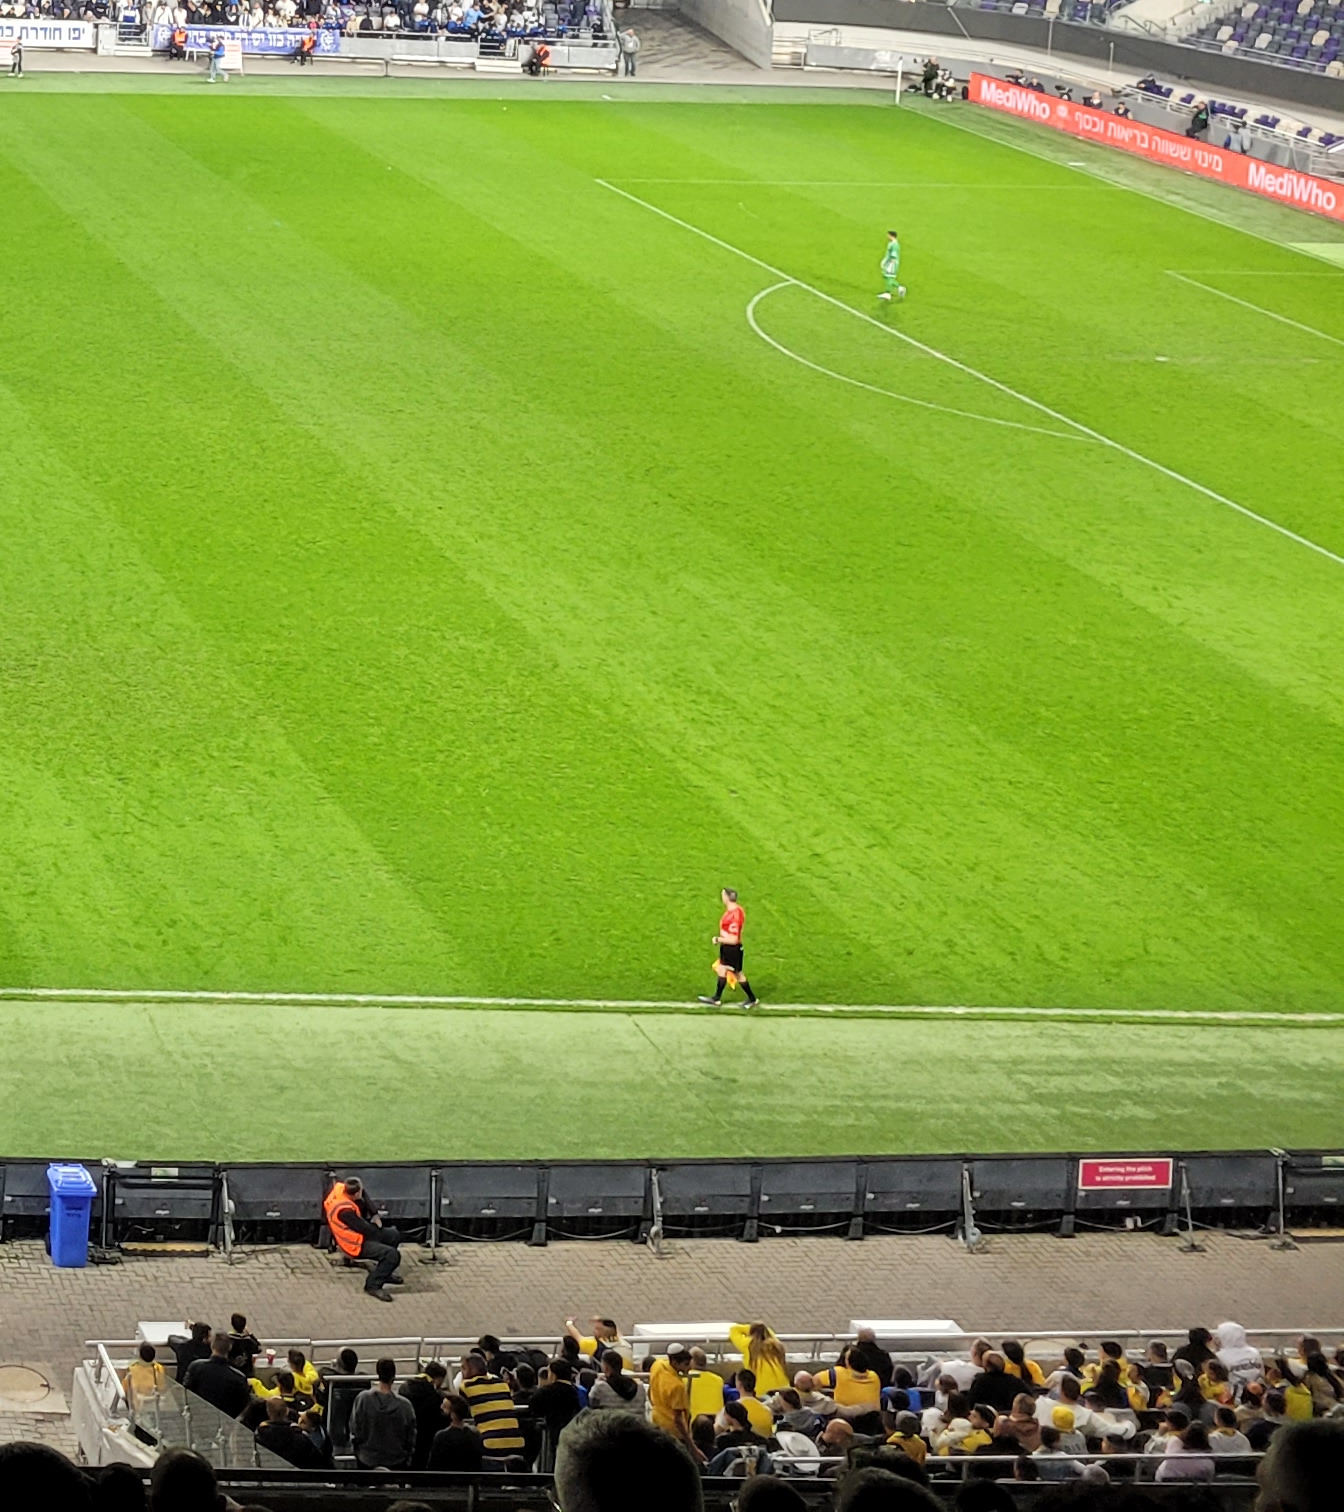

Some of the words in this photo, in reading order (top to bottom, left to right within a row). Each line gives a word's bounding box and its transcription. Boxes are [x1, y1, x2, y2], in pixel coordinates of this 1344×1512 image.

[20, 26, 62, 40] חודרת
[68, 26, 85, 41] יפו
[980, 79, 1051, 120] MediWho
[1075, 112, 1105, 132] וכסף
[1107, 120, 1150, 149] בריאות
[1151, 135, 1192, 162] ששווה
[1194, 149, 1224, 172] מינוי
[1247, 162, 1337, 211] MediWho
